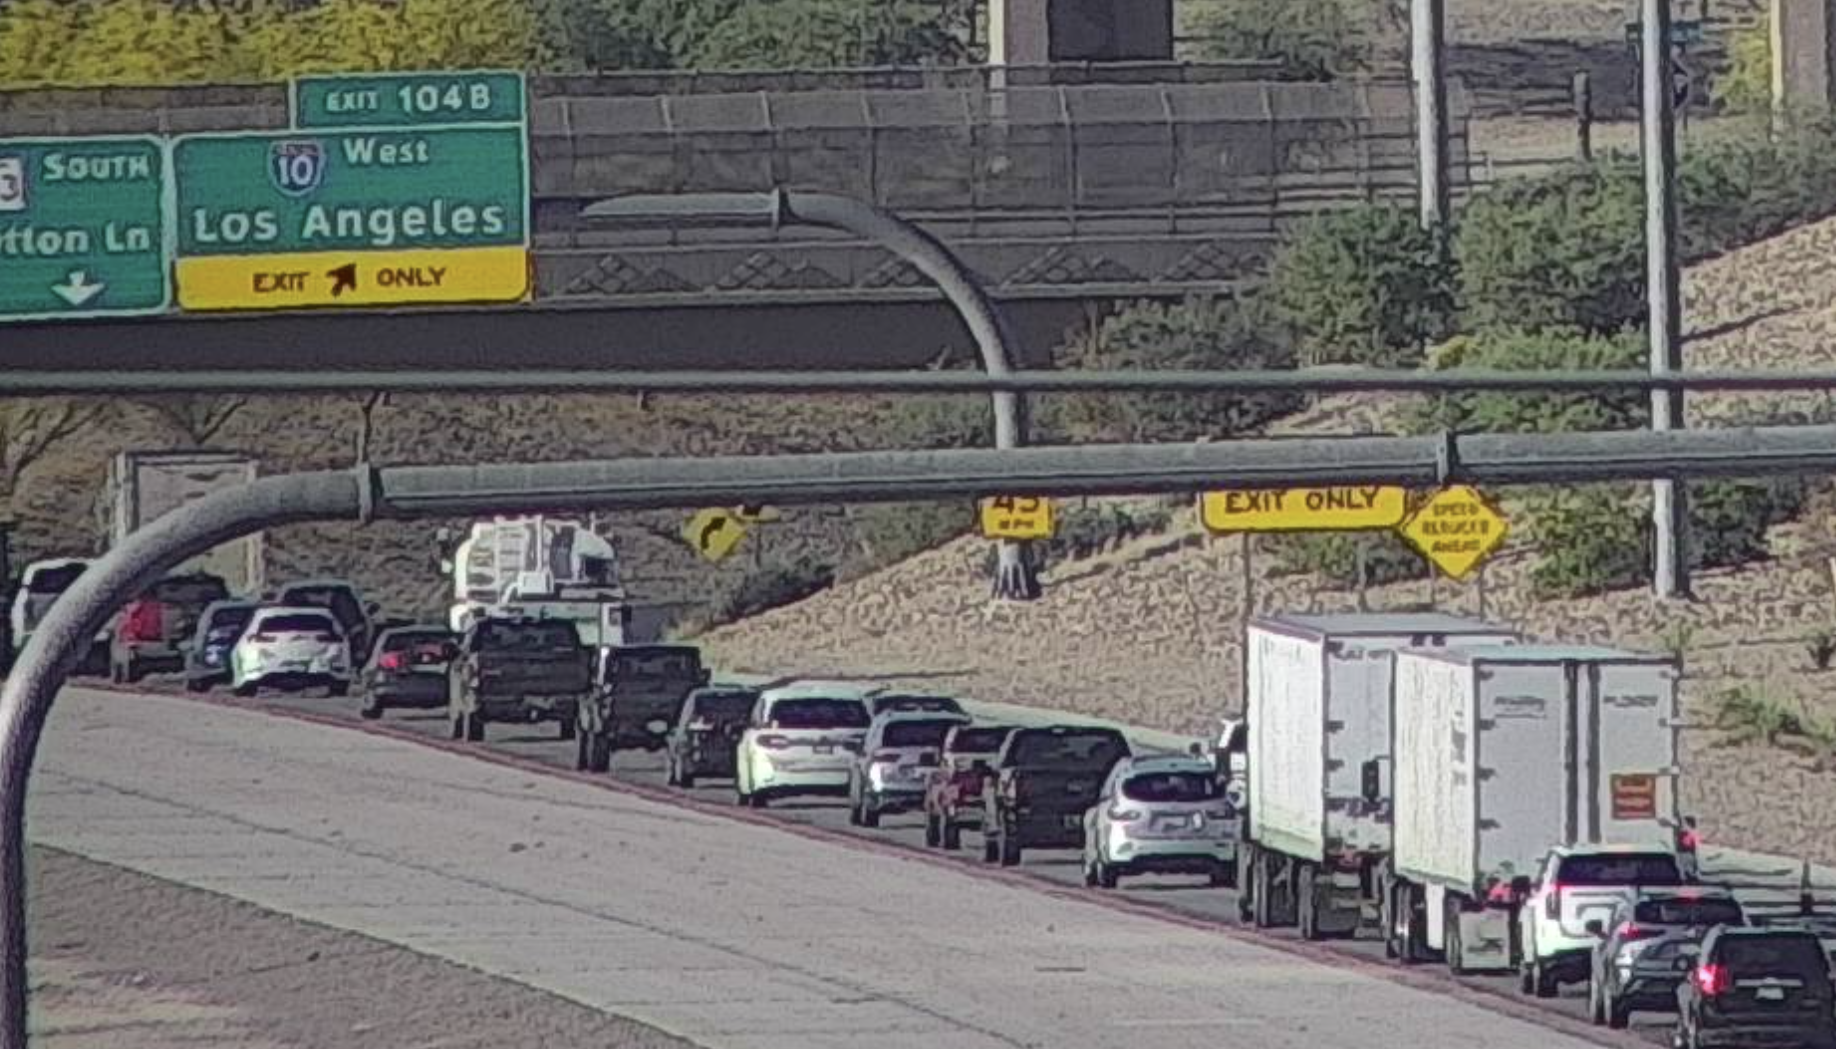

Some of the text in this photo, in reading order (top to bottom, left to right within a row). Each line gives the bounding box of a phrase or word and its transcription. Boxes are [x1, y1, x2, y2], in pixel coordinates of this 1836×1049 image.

[325, 83, 491, 112] EXIT 104B
[343, 137, 430, 164] West
[278, 153, 314, 186] 10
[105, 221, 150, 251] Ln
[194, 199, 504, 246] Los Angeles
[252, 265, 447, 294] EXIT ONLY
[1224, 487, 1380, 514] EXIT ONLY
